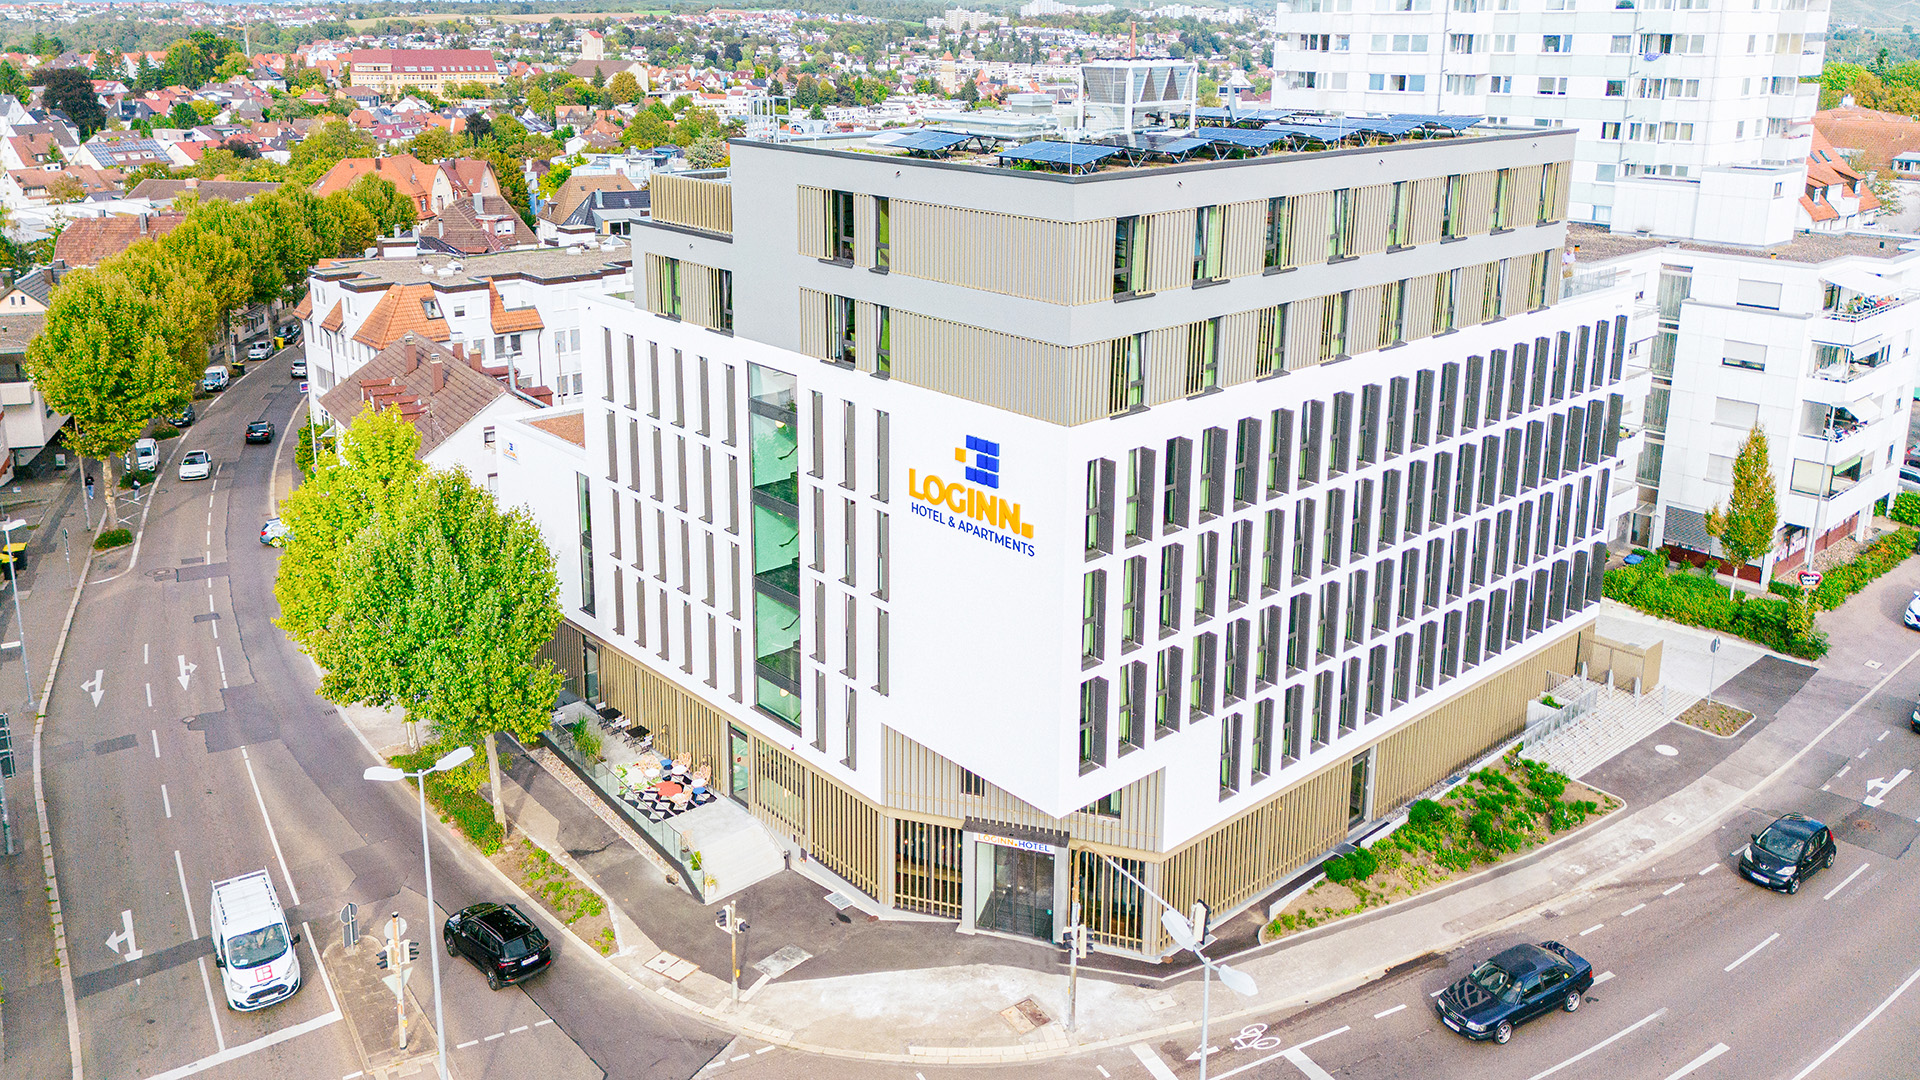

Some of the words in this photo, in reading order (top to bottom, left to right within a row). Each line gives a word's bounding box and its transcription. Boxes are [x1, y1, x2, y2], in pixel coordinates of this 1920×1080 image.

[911, 502, 946, 525] HOTEL
[948, 516, 956, 529] &
[958, 520, 1035, 557] APARTMENTS
